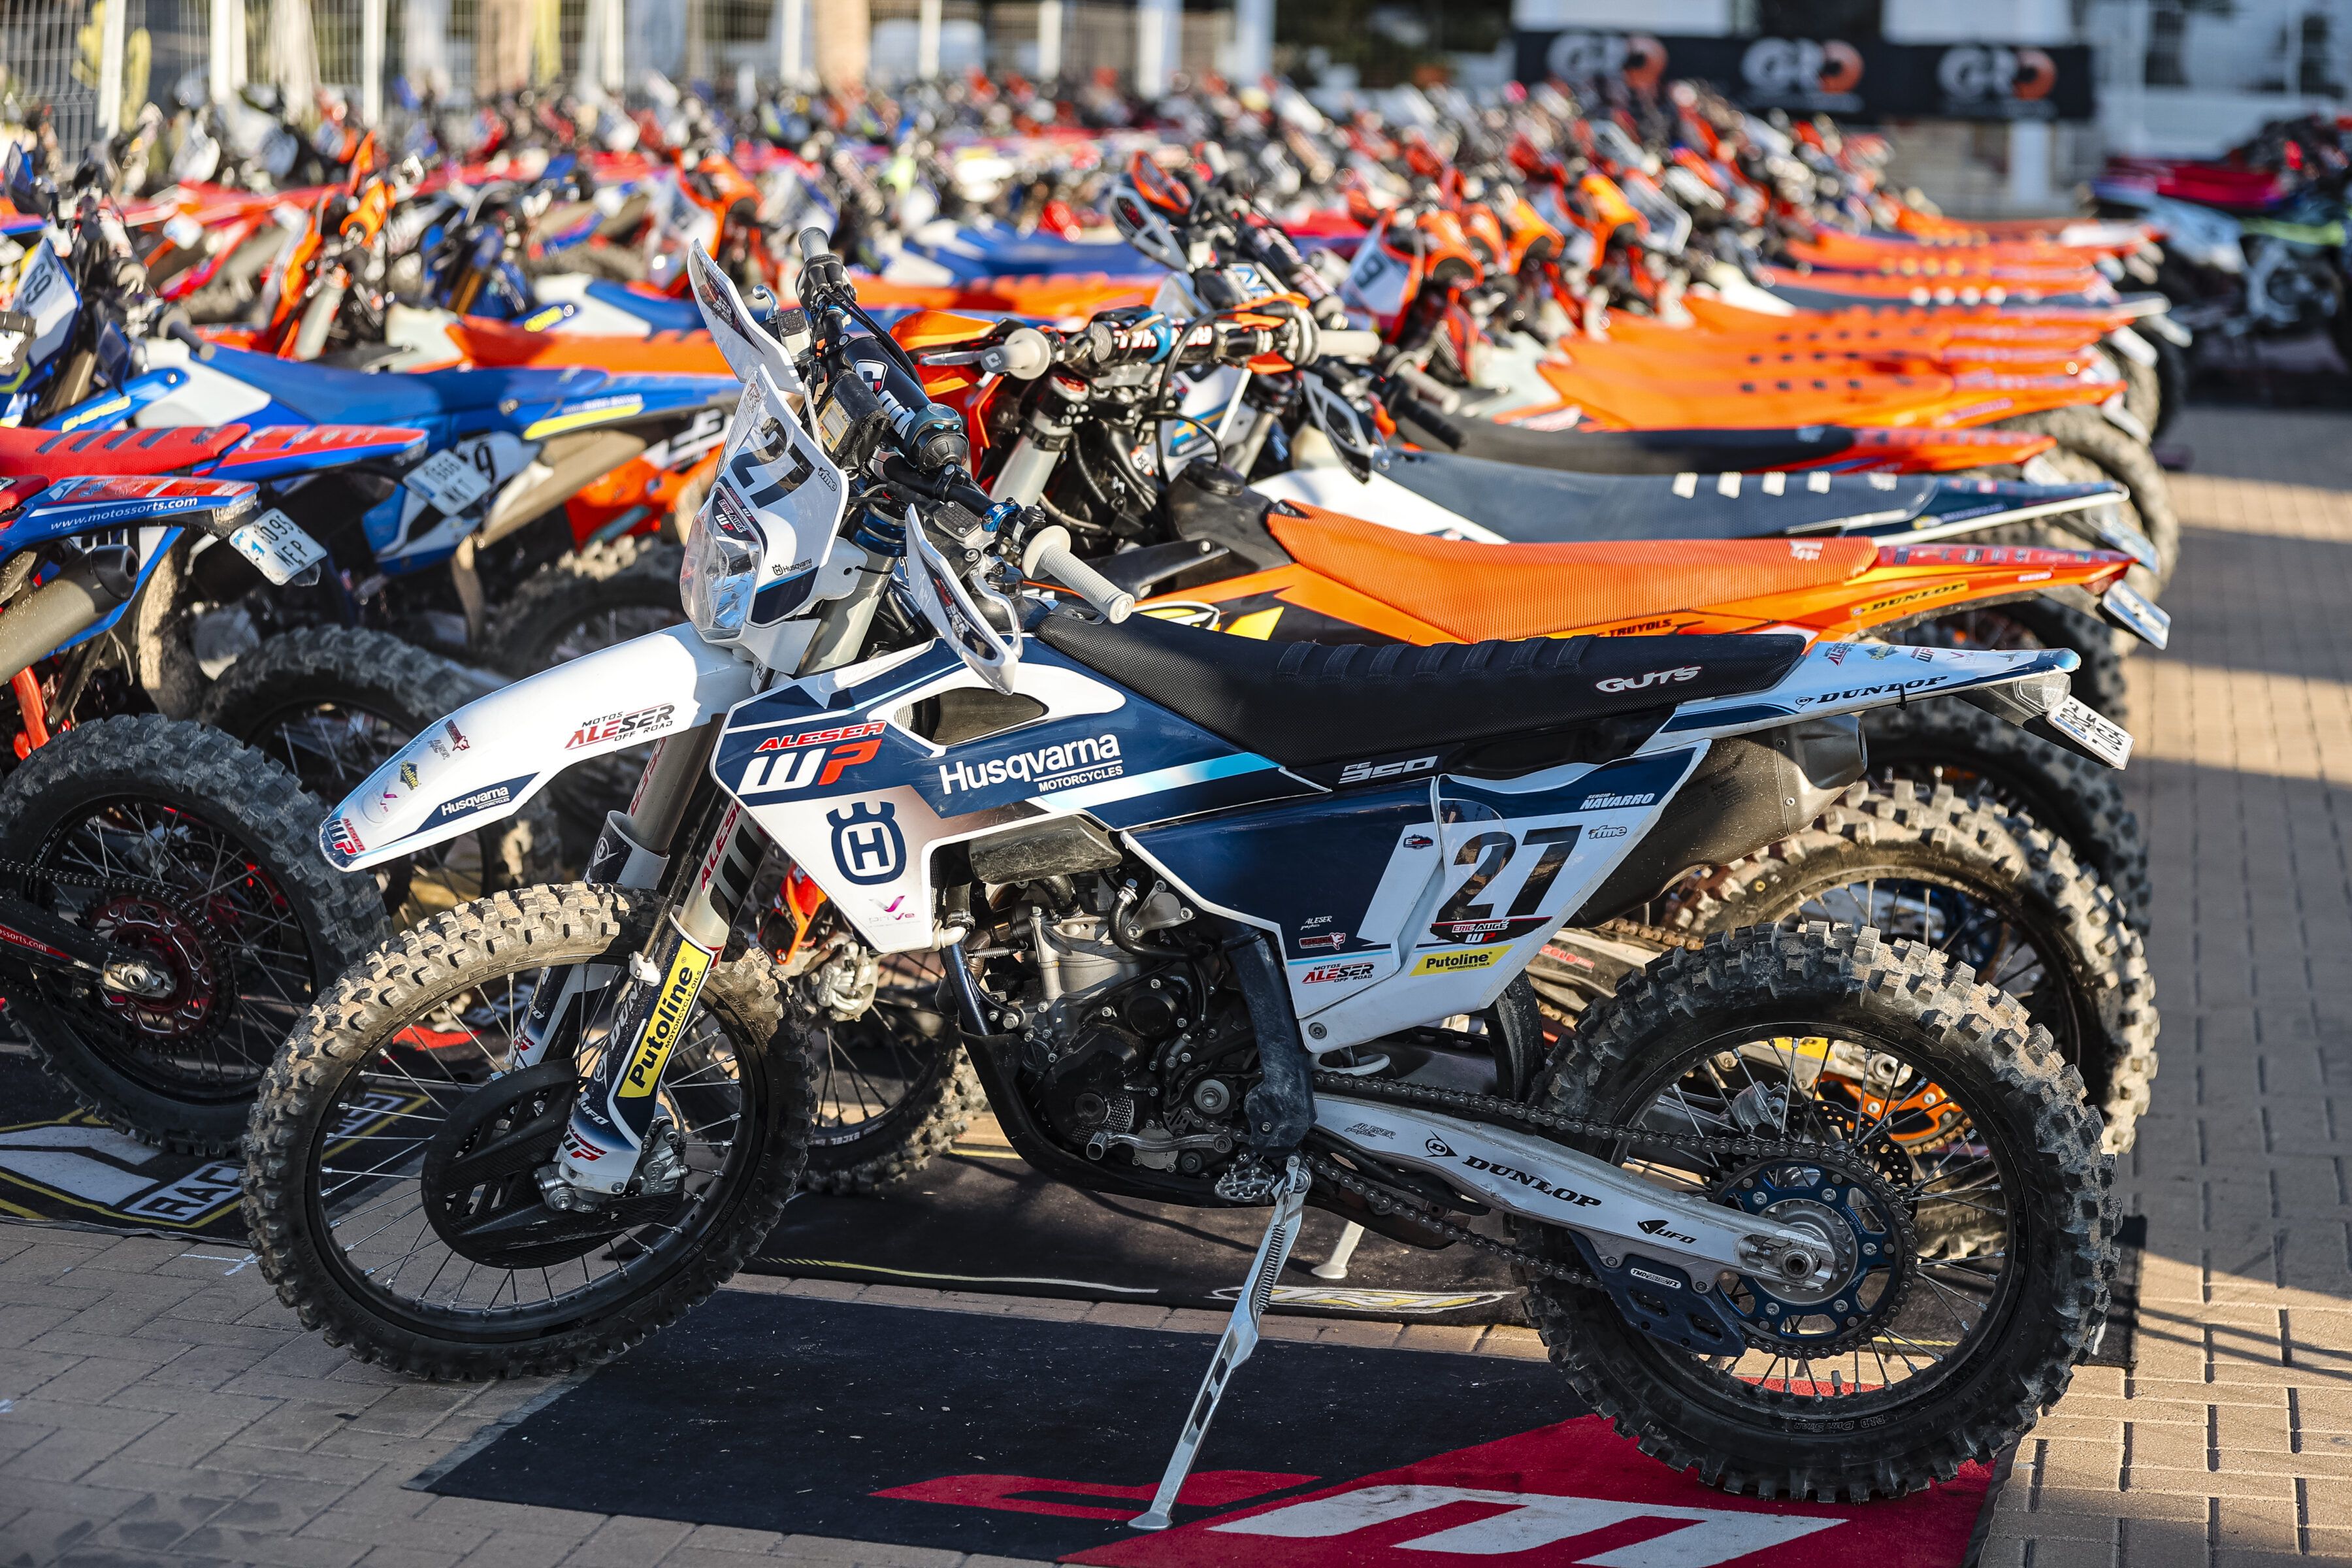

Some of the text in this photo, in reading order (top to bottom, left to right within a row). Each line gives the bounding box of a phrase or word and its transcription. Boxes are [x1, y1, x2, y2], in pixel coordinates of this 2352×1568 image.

[730, 416, 816, 509] 27
[50, 497, 198, 531] www.motossorts.com
[715, 514, 734, 531] WP
[783, 558, 813, 575] Husqvarna
[1871, 581, 1967, 612] DUNLOP
[1609, 619, 1673, 637] TRUYOLS
[1595, 666, 1702, 693] GUTS
[1816, 676, 1949, 704] DUNLOP
[564, 704, 675, 749] ALESER
[581, 711, 624, 727] MOTOS
[614, 720, 674, 742] OFF ROAD
[753, 720, 887, 753] ALESER
[400, 760, 419, 789] Putoline
[736, 738, 883, 796] WP
[938, 733, 1121, 795] Husqvarna
[1338, 755, 1438, 784] 350
[1343, 761, 1371, 772] FE
[1038, 765, 1124, 792] MOTORCYCLES
[440, 785, 509, 816] Husqvarna
[1579, 792, 1655, 811] NAVARRO
[325, 819, 359, 857] WP
[1435, 825, 1584, 923] 27
[1304, 915, 1333, 925] ALESER
[1451, 923, 1475, 933] ERIC
[1465, 932, 1495, 944] WP
[1301, 964, 1375, 983] ALESER
[1426, 953, 1490, 970] Putoline
[664, 970, 702, 1049] MOTORCYCLE OILS
[629, 966, 693, 1089] Putoline
[580, 1101, 610, 1125] UFO
[1462, 1154, 1603, 1208] DUNLOP
[1657, 1228, 1697, 1245] UFO
[1632, 1269, 1647, 1278] TMD
